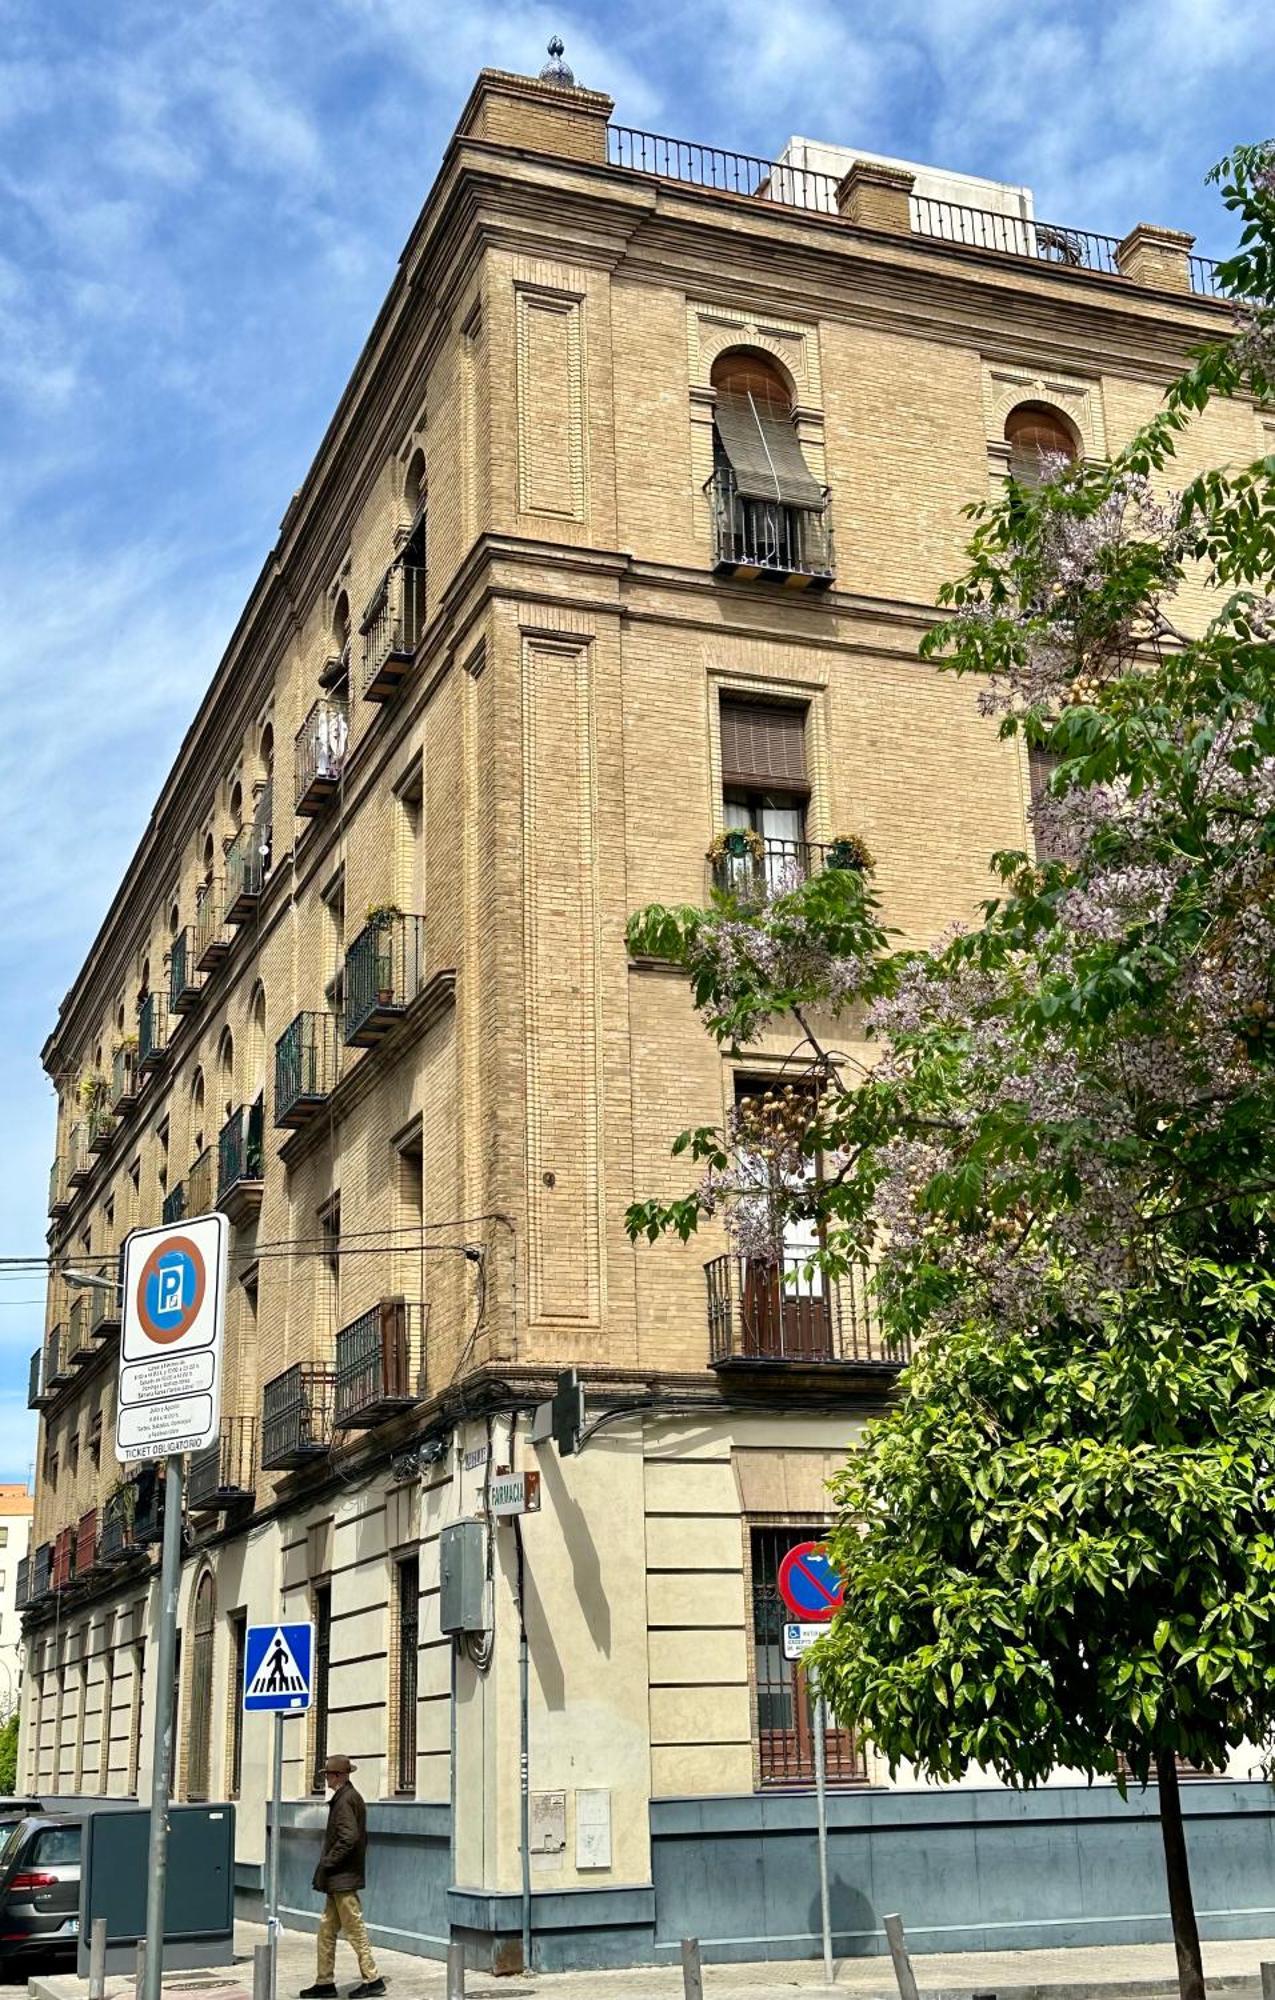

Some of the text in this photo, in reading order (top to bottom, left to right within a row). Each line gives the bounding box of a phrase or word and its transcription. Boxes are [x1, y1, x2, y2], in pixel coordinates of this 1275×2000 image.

[126, 1439, 202, 1459] TICKET OBLIGATORIO
[492, 1483, 524, 1506] FARMACIA
